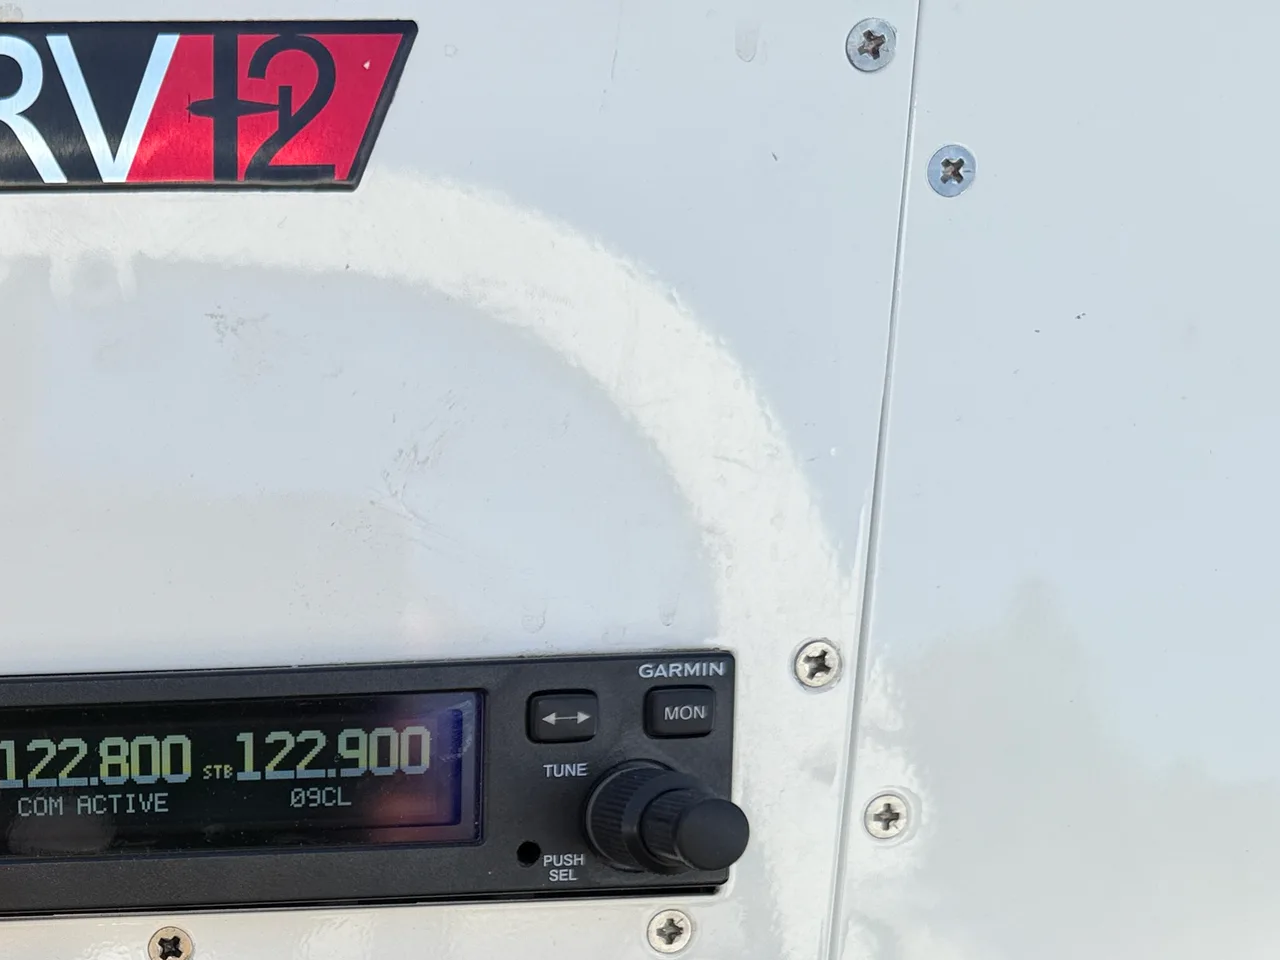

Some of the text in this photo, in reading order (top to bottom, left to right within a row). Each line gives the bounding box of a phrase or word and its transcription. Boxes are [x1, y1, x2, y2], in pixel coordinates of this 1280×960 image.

[638, 662, 725, 678] GARMIN
[664, 705, 705, 720] MON
[203, 726, 431, 781] STB 122.900
[543, 763, 588, 778] TUNE
[18, 792, 169, 816] COM ACTIVE
[543, 854, 584, 867] PUSH
[549, 869, 577, 882] SEL
